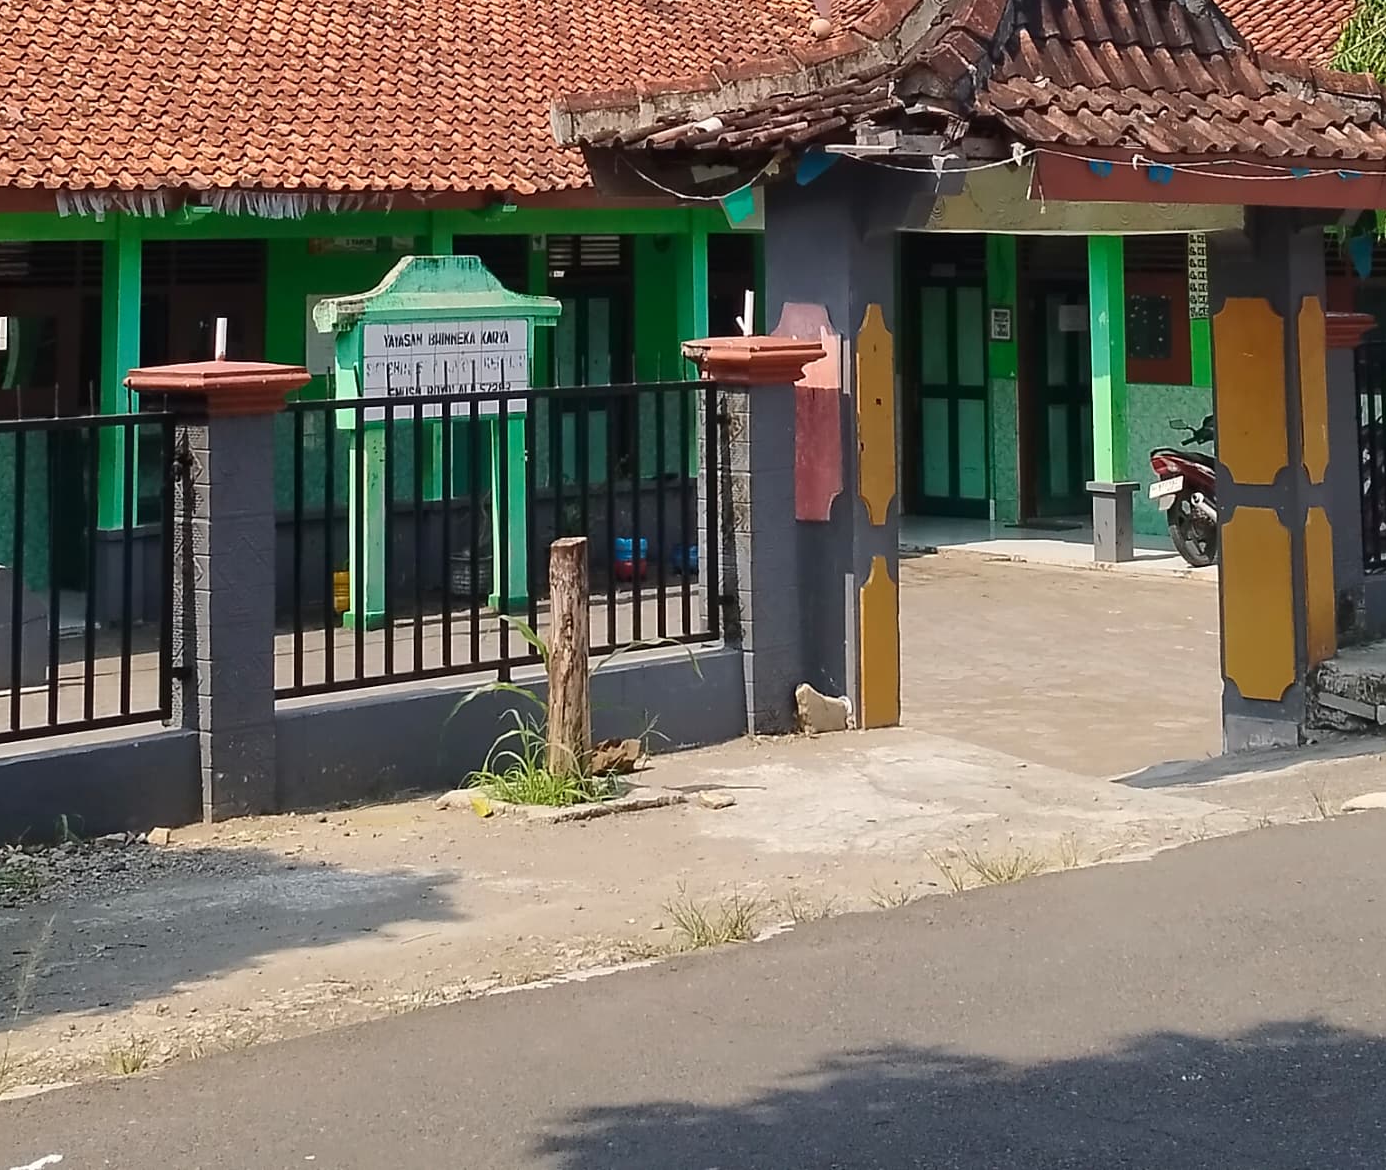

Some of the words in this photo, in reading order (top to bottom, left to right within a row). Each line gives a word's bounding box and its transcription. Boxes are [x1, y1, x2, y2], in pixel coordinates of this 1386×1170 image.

[384, 333, 423, 348] YAYASAN
[428, 331, 476, 346] BHINNEKA
[481, 330, 509, 345] KARYA
